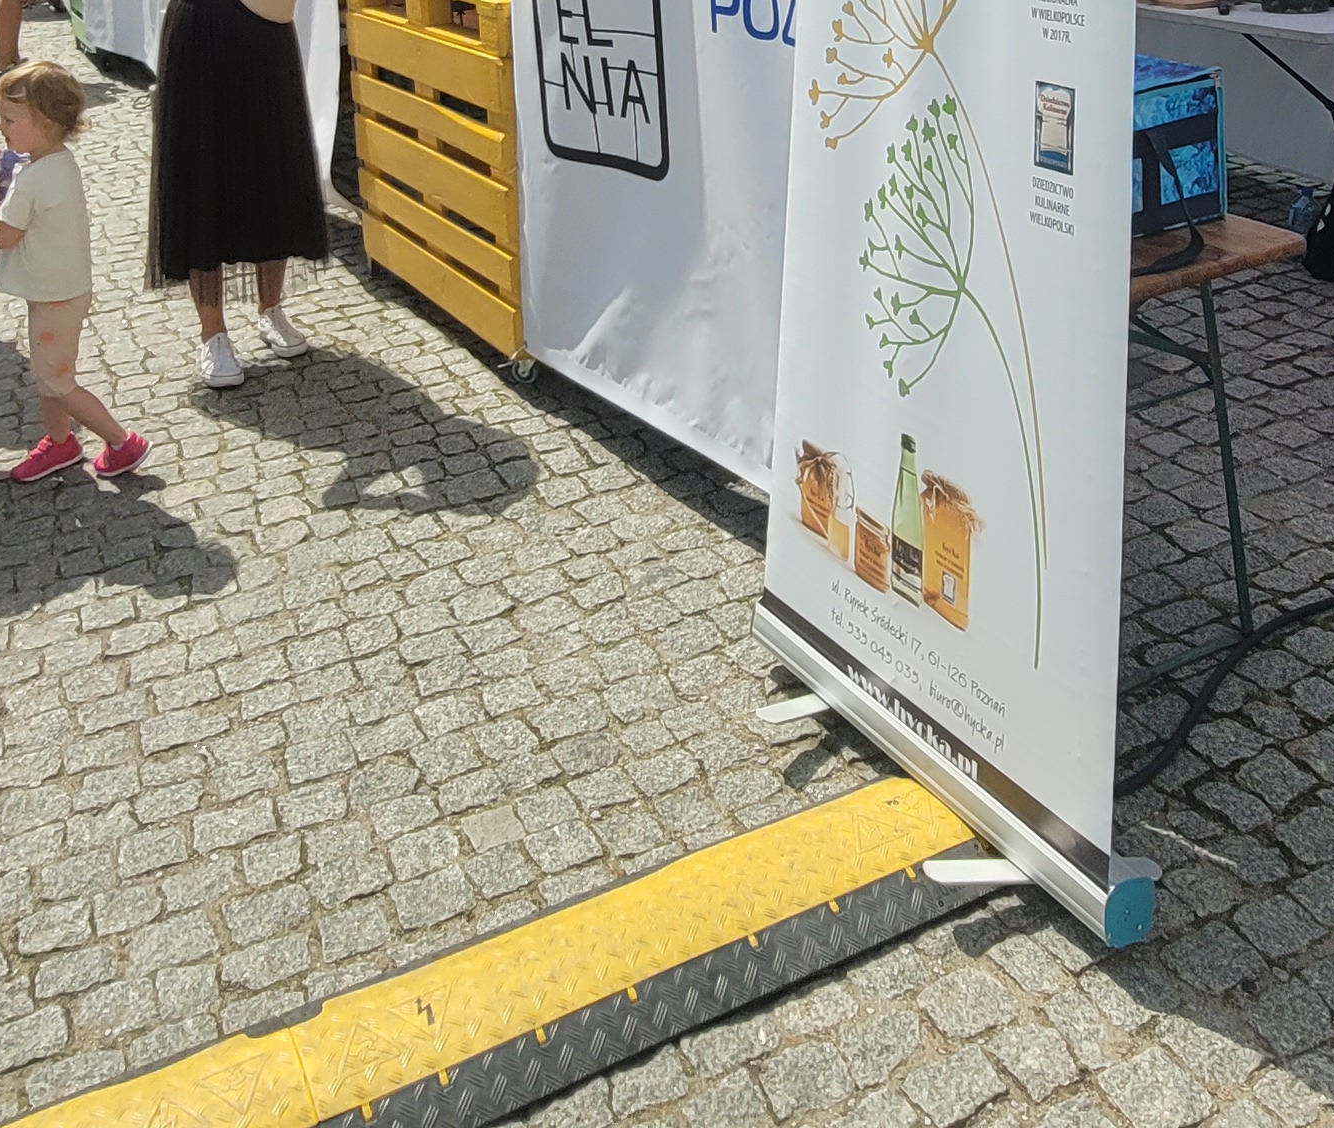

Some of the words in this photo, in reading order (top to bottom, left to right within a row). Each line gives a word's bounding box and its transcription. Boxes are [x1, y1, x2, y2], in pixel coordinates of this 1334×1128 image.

[1031, 6, 1038, 19] W
[1038, 8, 1086, 27] WIELKOPOLSCE
[1042, 27, 1049, 39] W
[560, 52, 651, 124] NIA
[1032, 176, 1074, 199] DZIEDZICTWO
[1035, 195, 1070, 216] KULINARNE
[1030, 211, 1075, 236] WIELKOPOLSKI
[831, 607, 844, 629] tel.
[847, 621, 868, 645] 535
[870, 640, 893, 664] 045
[831, 579, 841, 596] ul.
[844, 587, 869, 618] Rynek
[927, 650, 968, 689] 61-126
[970, 679, 1006, 718] Poznań
[846, 664, 979, 782] www.hycka.pl
